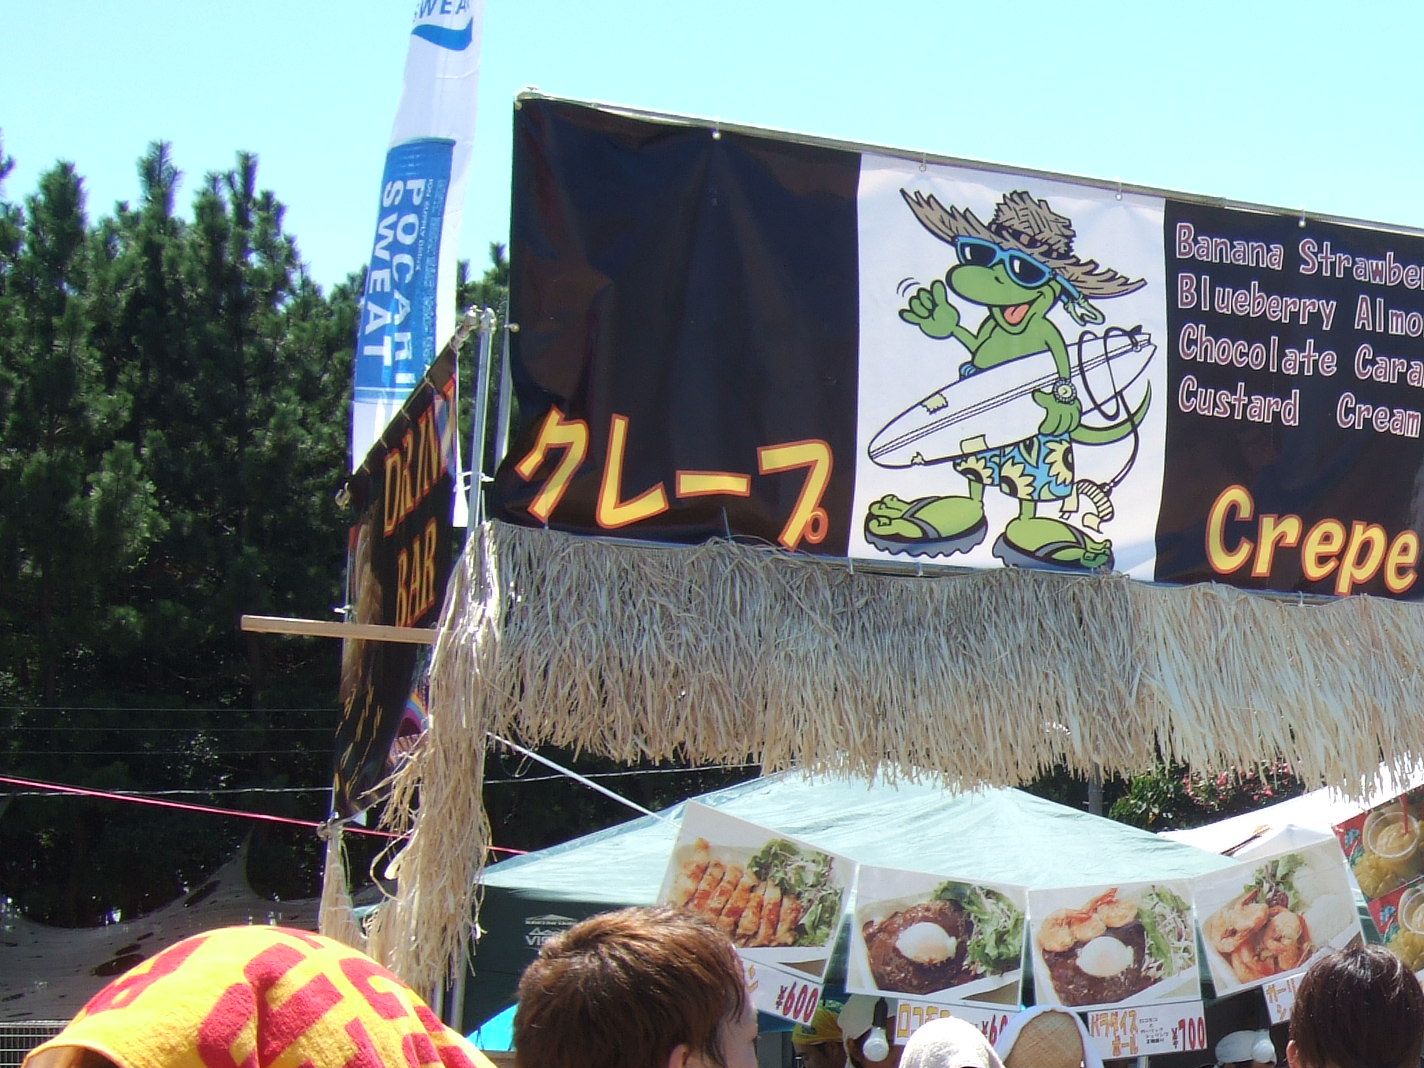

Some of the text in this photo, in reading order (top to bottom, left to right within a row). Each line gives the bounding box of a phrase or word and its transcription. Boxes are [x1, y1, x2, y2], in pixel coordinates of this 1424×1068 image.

[363, 179, 404, 367] SWEAT
[1175, 222, 1285, 270] Banana
[1178, 272, 1336, 331] Blueberry
[1179, 323, 1337, 377] Chocolate
[1178, 374, 1422, 438] Custard Cream
[383, 405, 444, 538] DRIN
[514, 404, 834, 551] クレープ
[1205, 484, 1421, 596] Crepe
[396, 517, 438, 629] BAR
[776, 981, 820, 1023] ¥600
[1171, 1016, 1208, 1051] ¥700
